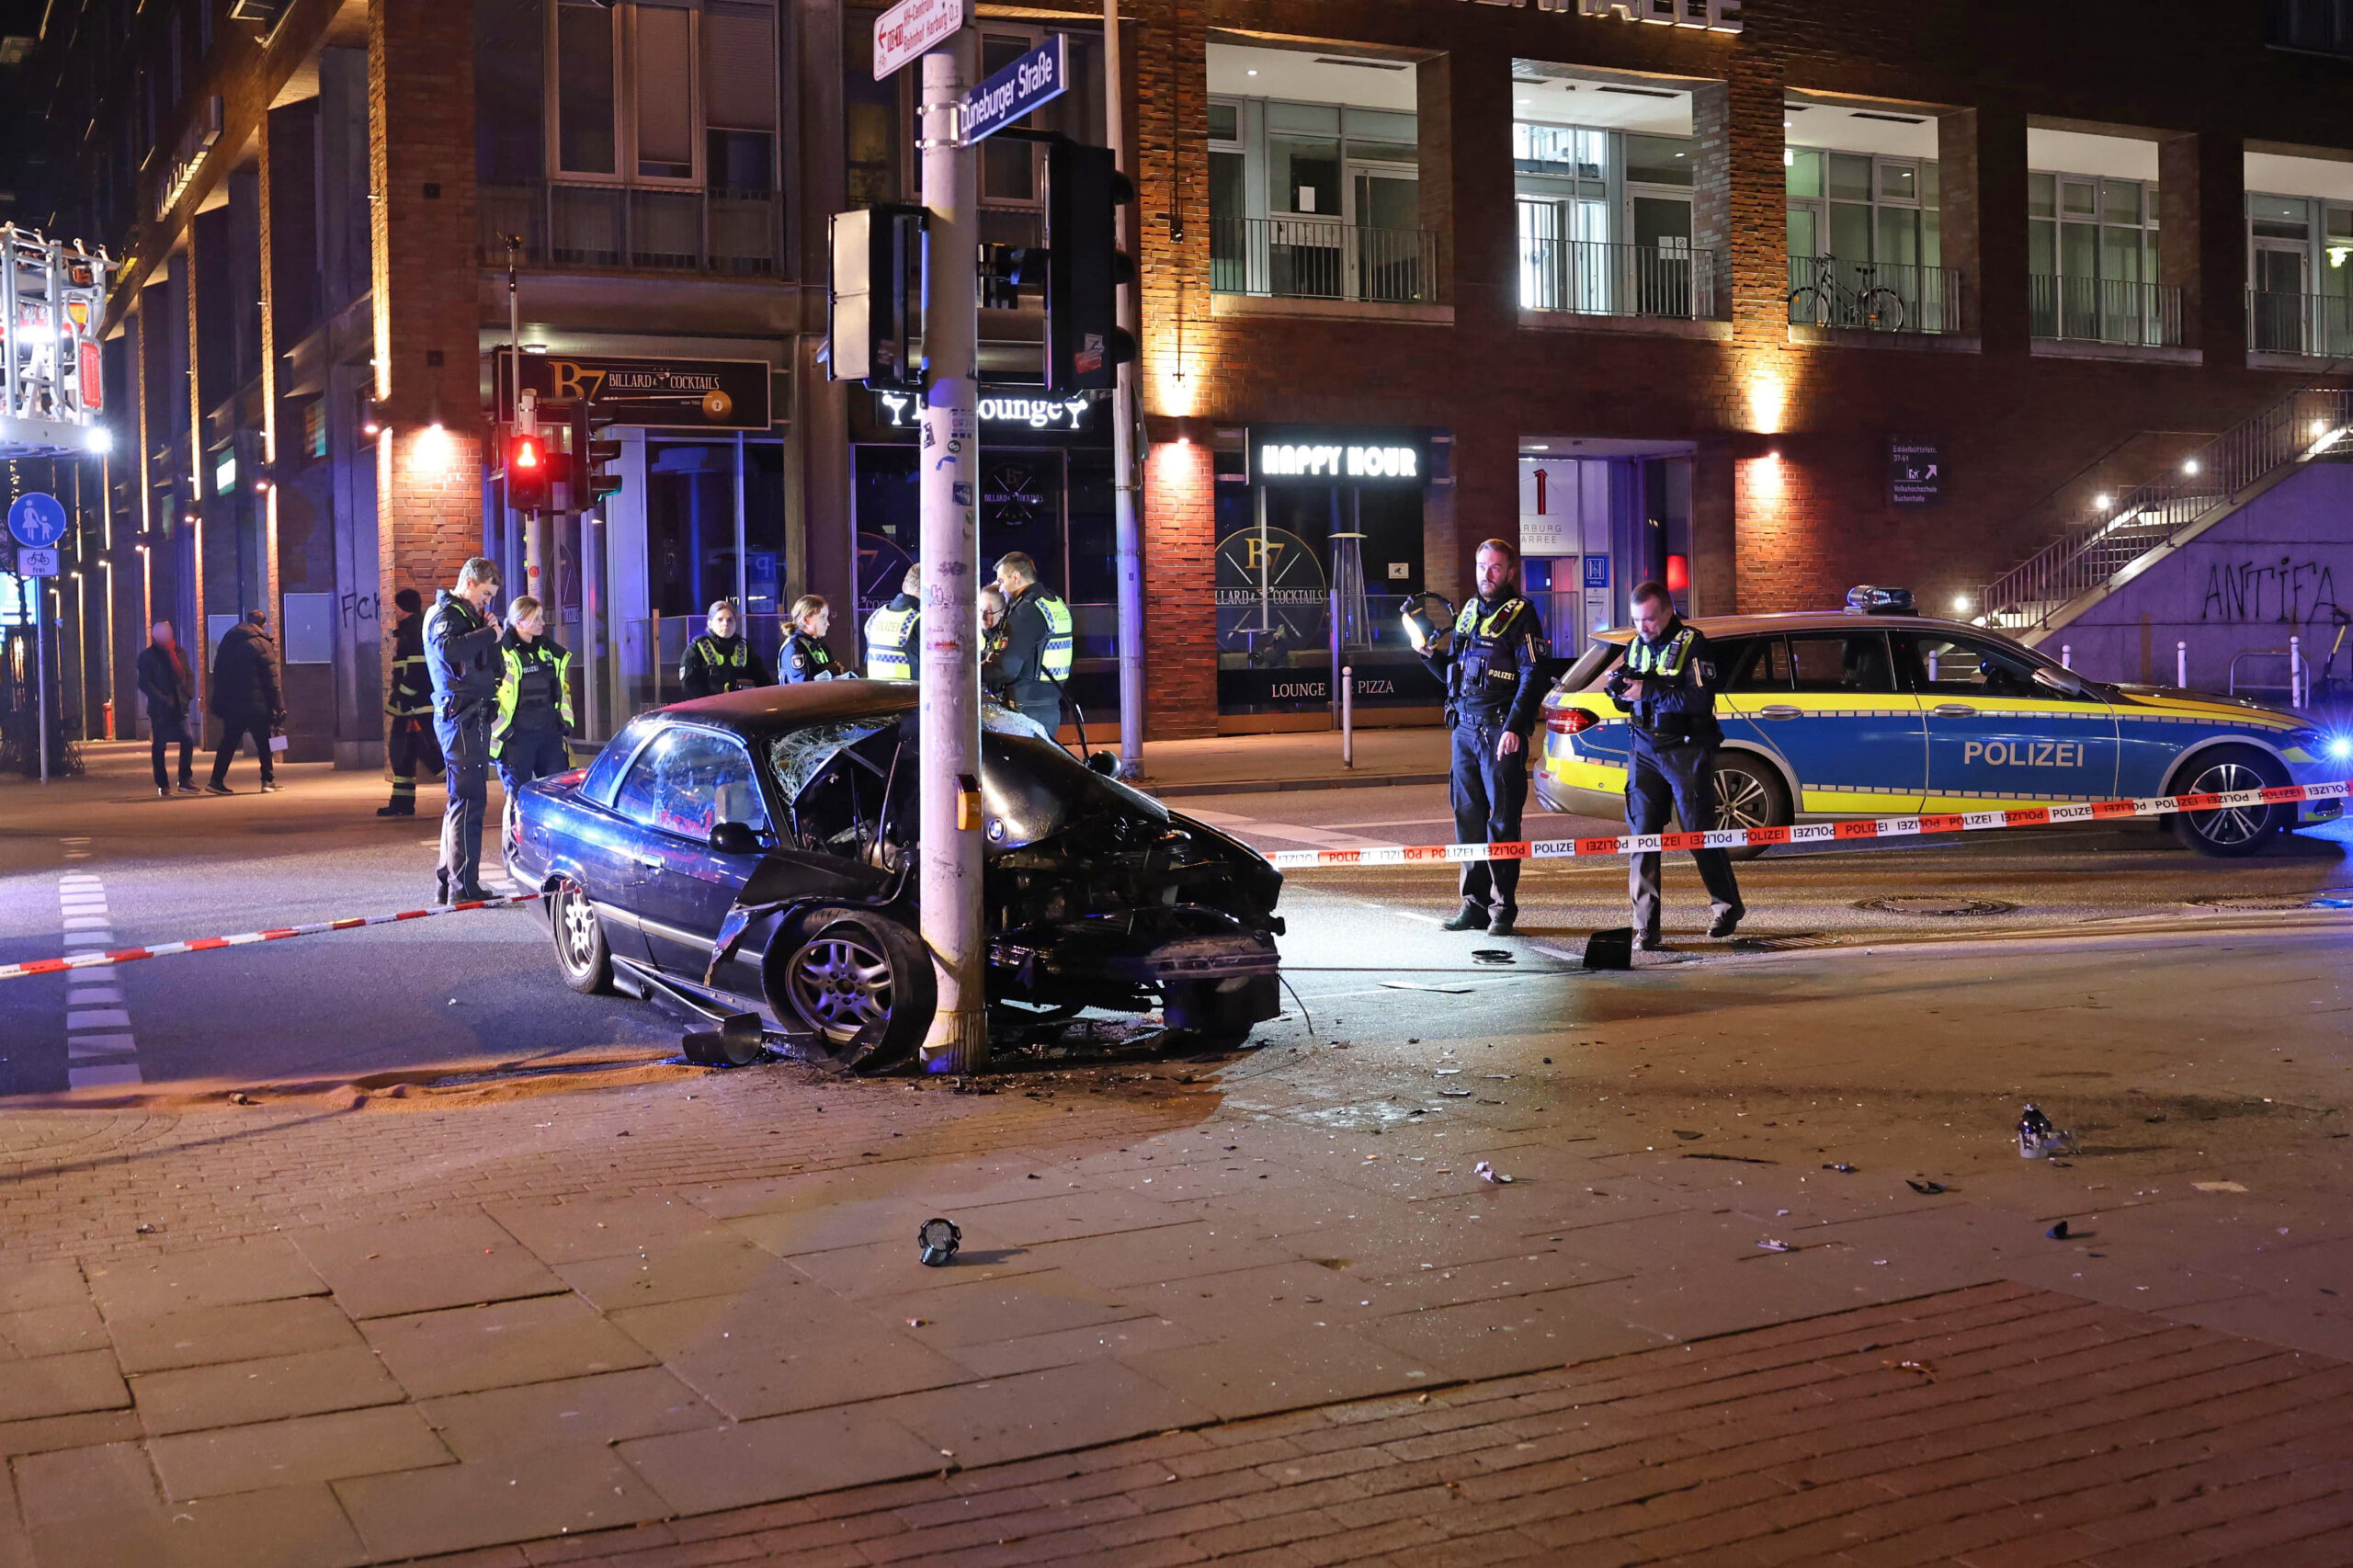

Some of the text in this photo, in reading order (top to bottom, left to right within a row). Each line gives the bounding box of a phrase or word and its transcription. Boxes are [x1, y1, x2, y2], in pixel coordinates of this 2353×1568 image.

[904, 23, 926, 52] Bahnhof
[926, 12, 948, 38] Harburg
[961, 51, 1052, 134] Lüneburger Straße
[548, 359, 607, 401] B7
[608, 372, 652, 388] BILLARD
[669, 375, 721, 391] COCKTAILS
[976, 398, 1063, 427] ounge
[1262, 445, 1417, 477] HAPPY HOUR
[1520, 524, 1562, 533] RBURG
[1520, 535, 1557, 544] ARREE
[32, 566, 46, 574] frei
[1245, 538, 1285, 575] B7
[1215, 590, 1250, 605] LLARD
[1273, 589, 1324, 605] COCKTAILS
[1488, 668, 1515, 681] POLIZEI
[1271, 682, 1326, 698] LOUNGE
[1358, 679, 1394, 694] PIZZA
[1963, 741, 2084, 767] POLIZEI
[1431, 847, 1472, 858] POLIZEI
[1483, 844, 1525, 856] POLIZEI
[1534, 842, 1575, 854] POLIZEI
[1586, 839, 1629, 851] POLIZEI
[1638, 836, 1680, 848] POLIZEI
[1689, 834, 1732, 845] POLIZEI
[1742, 829, 1784, 842] POLIZEI
[1793, 826, 1836, 838] POLIZEI
[1846, 823, 1888, 835] POLIZEI
[1897, 819, 1939, 829] POLIZEI
[1949, 814, 1992, 825] POLIZEI
[2001, 811, 2043, 822] POLIZEI
[2052, 806, 2094, 818] POLIZEI
[2104, 801, 2146, 812] POLIZEI
[2154, 797, 2198, 809] POLIZEI
[2207, 793, 2249, 804] POLIZEI
[2257, 788, 2300, 800] POLIZEI
[2308, 783, 2351, 794] POLIZEI
